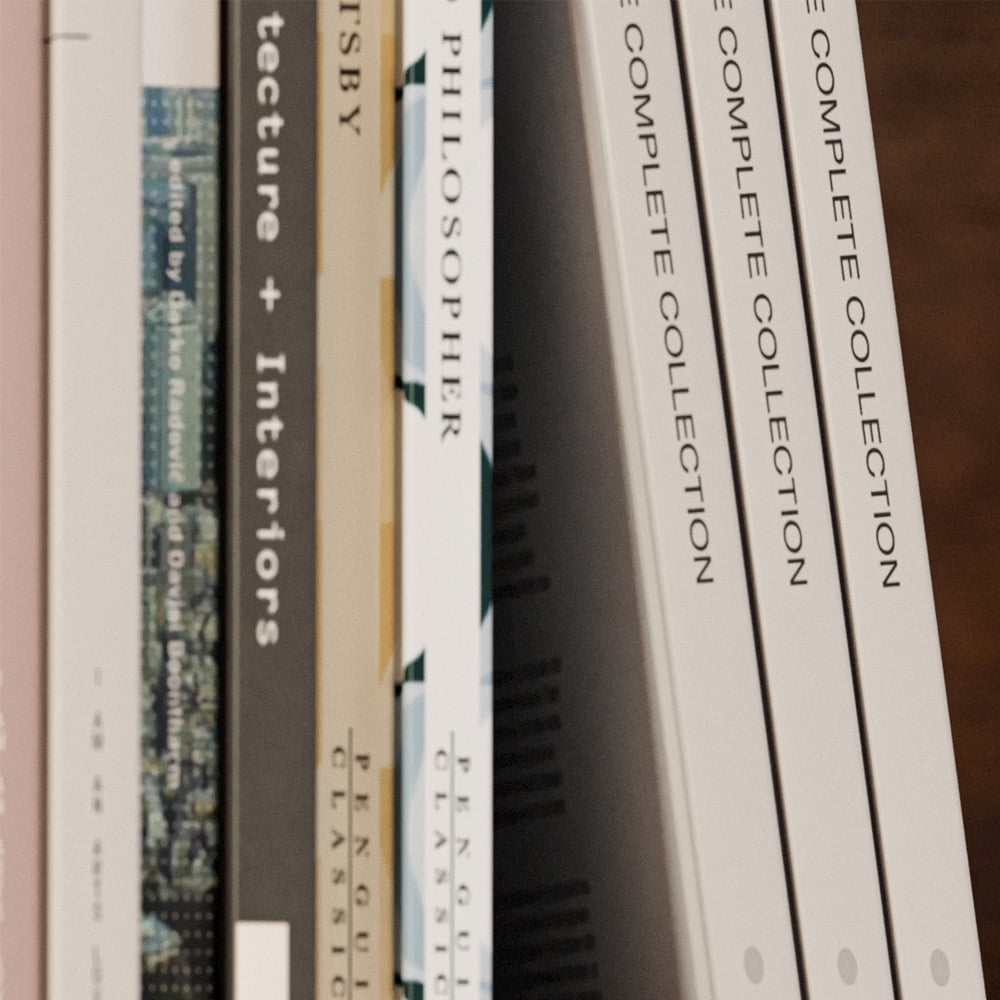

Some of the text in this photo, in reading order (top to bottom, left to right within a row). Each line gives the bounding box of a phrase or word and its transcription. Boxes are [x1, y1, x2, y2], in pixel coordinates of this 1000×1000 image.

[167, 158, 186, 243] edited
[256, 11, 285, 244] tecture
[339, 0, 362, 137] TSBY
[164, 250, 186, 284] by
[441, 33, 463, 443] PHILOSOPHER
[624, 22, 715, 585] COMPLETE COLLECTION
[718, 25, 809, 586] COMPLETE COLLECTION
[810, 28, 861, 282] COMPLETE
[845, 295, 901, 588] COLLECTION
[256, 353, 287, 647] Interiors
